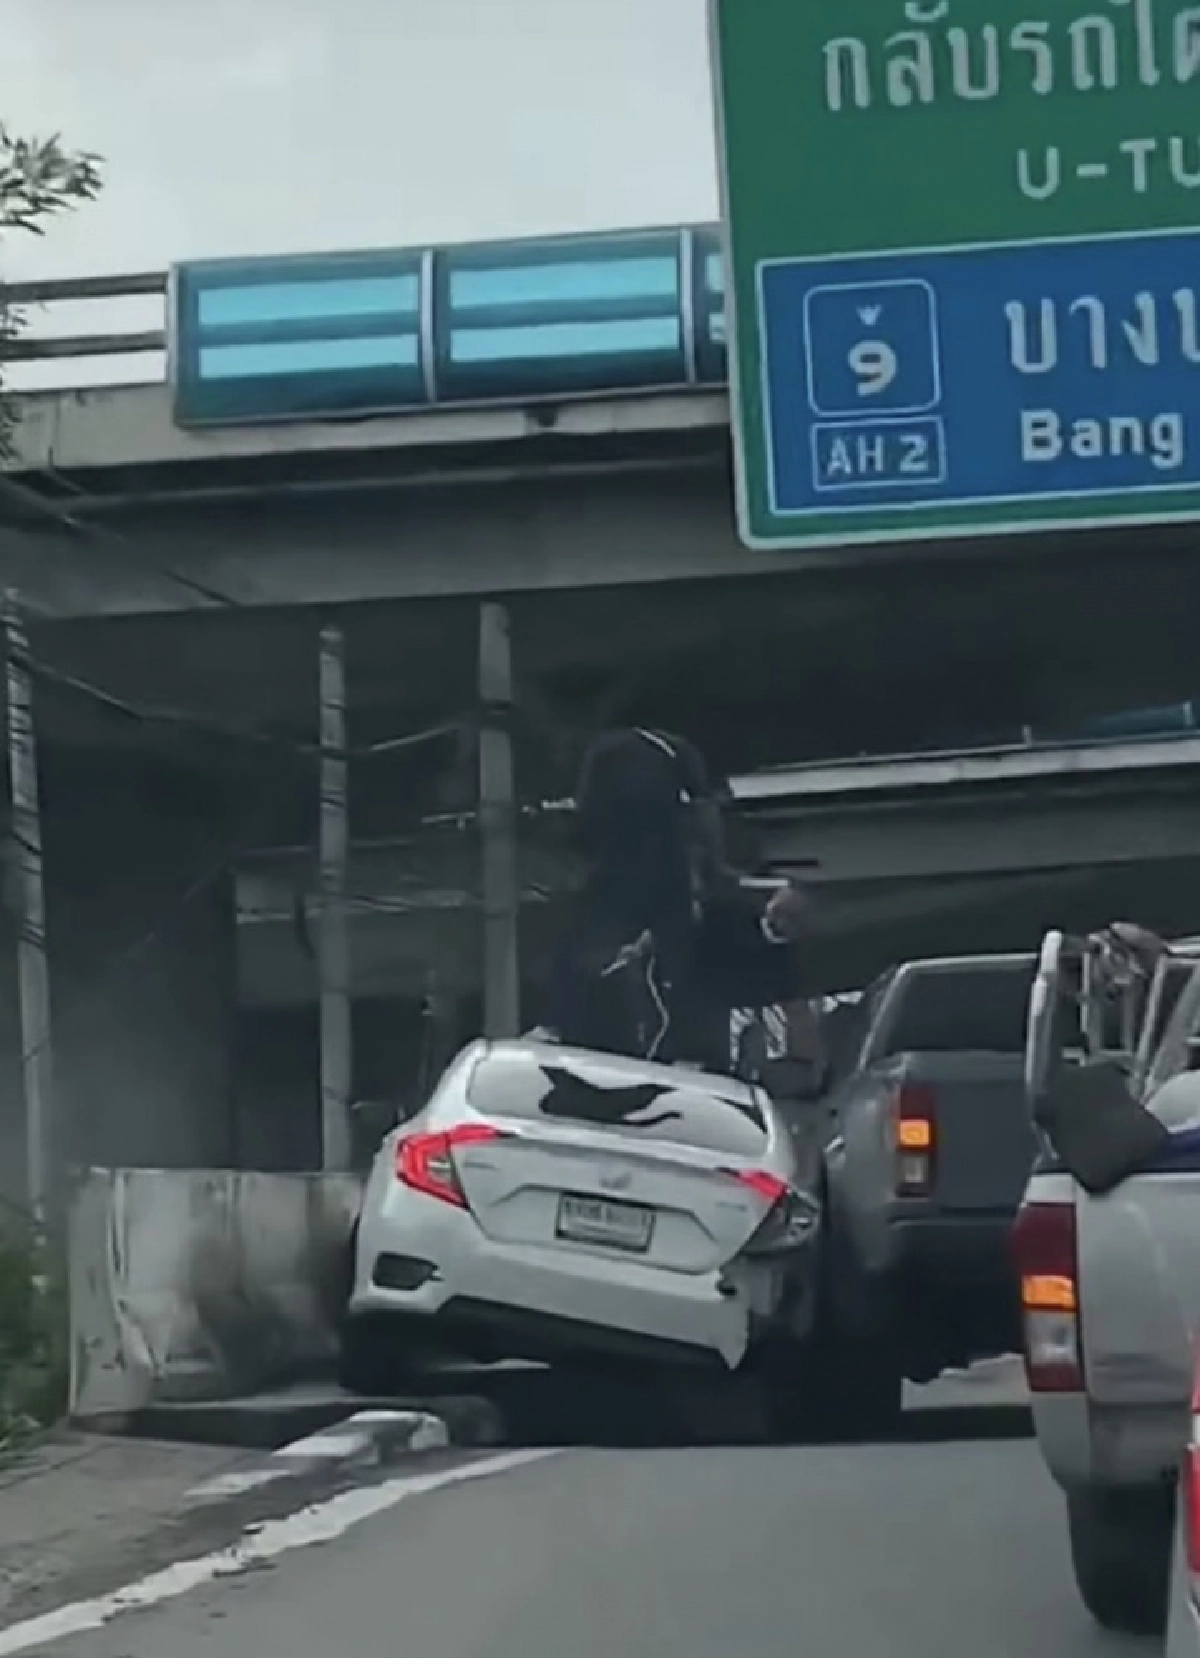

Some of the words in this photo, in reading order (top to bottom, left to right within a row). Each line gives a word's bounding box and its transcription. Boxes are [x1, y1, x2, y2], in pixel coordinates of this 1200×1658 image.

[848, 339, 897, 397] 9
[827, 435, 884, 475] AH
[899, 434, 929, 473] 2
[1020, 409, 1184, 470] Bang
